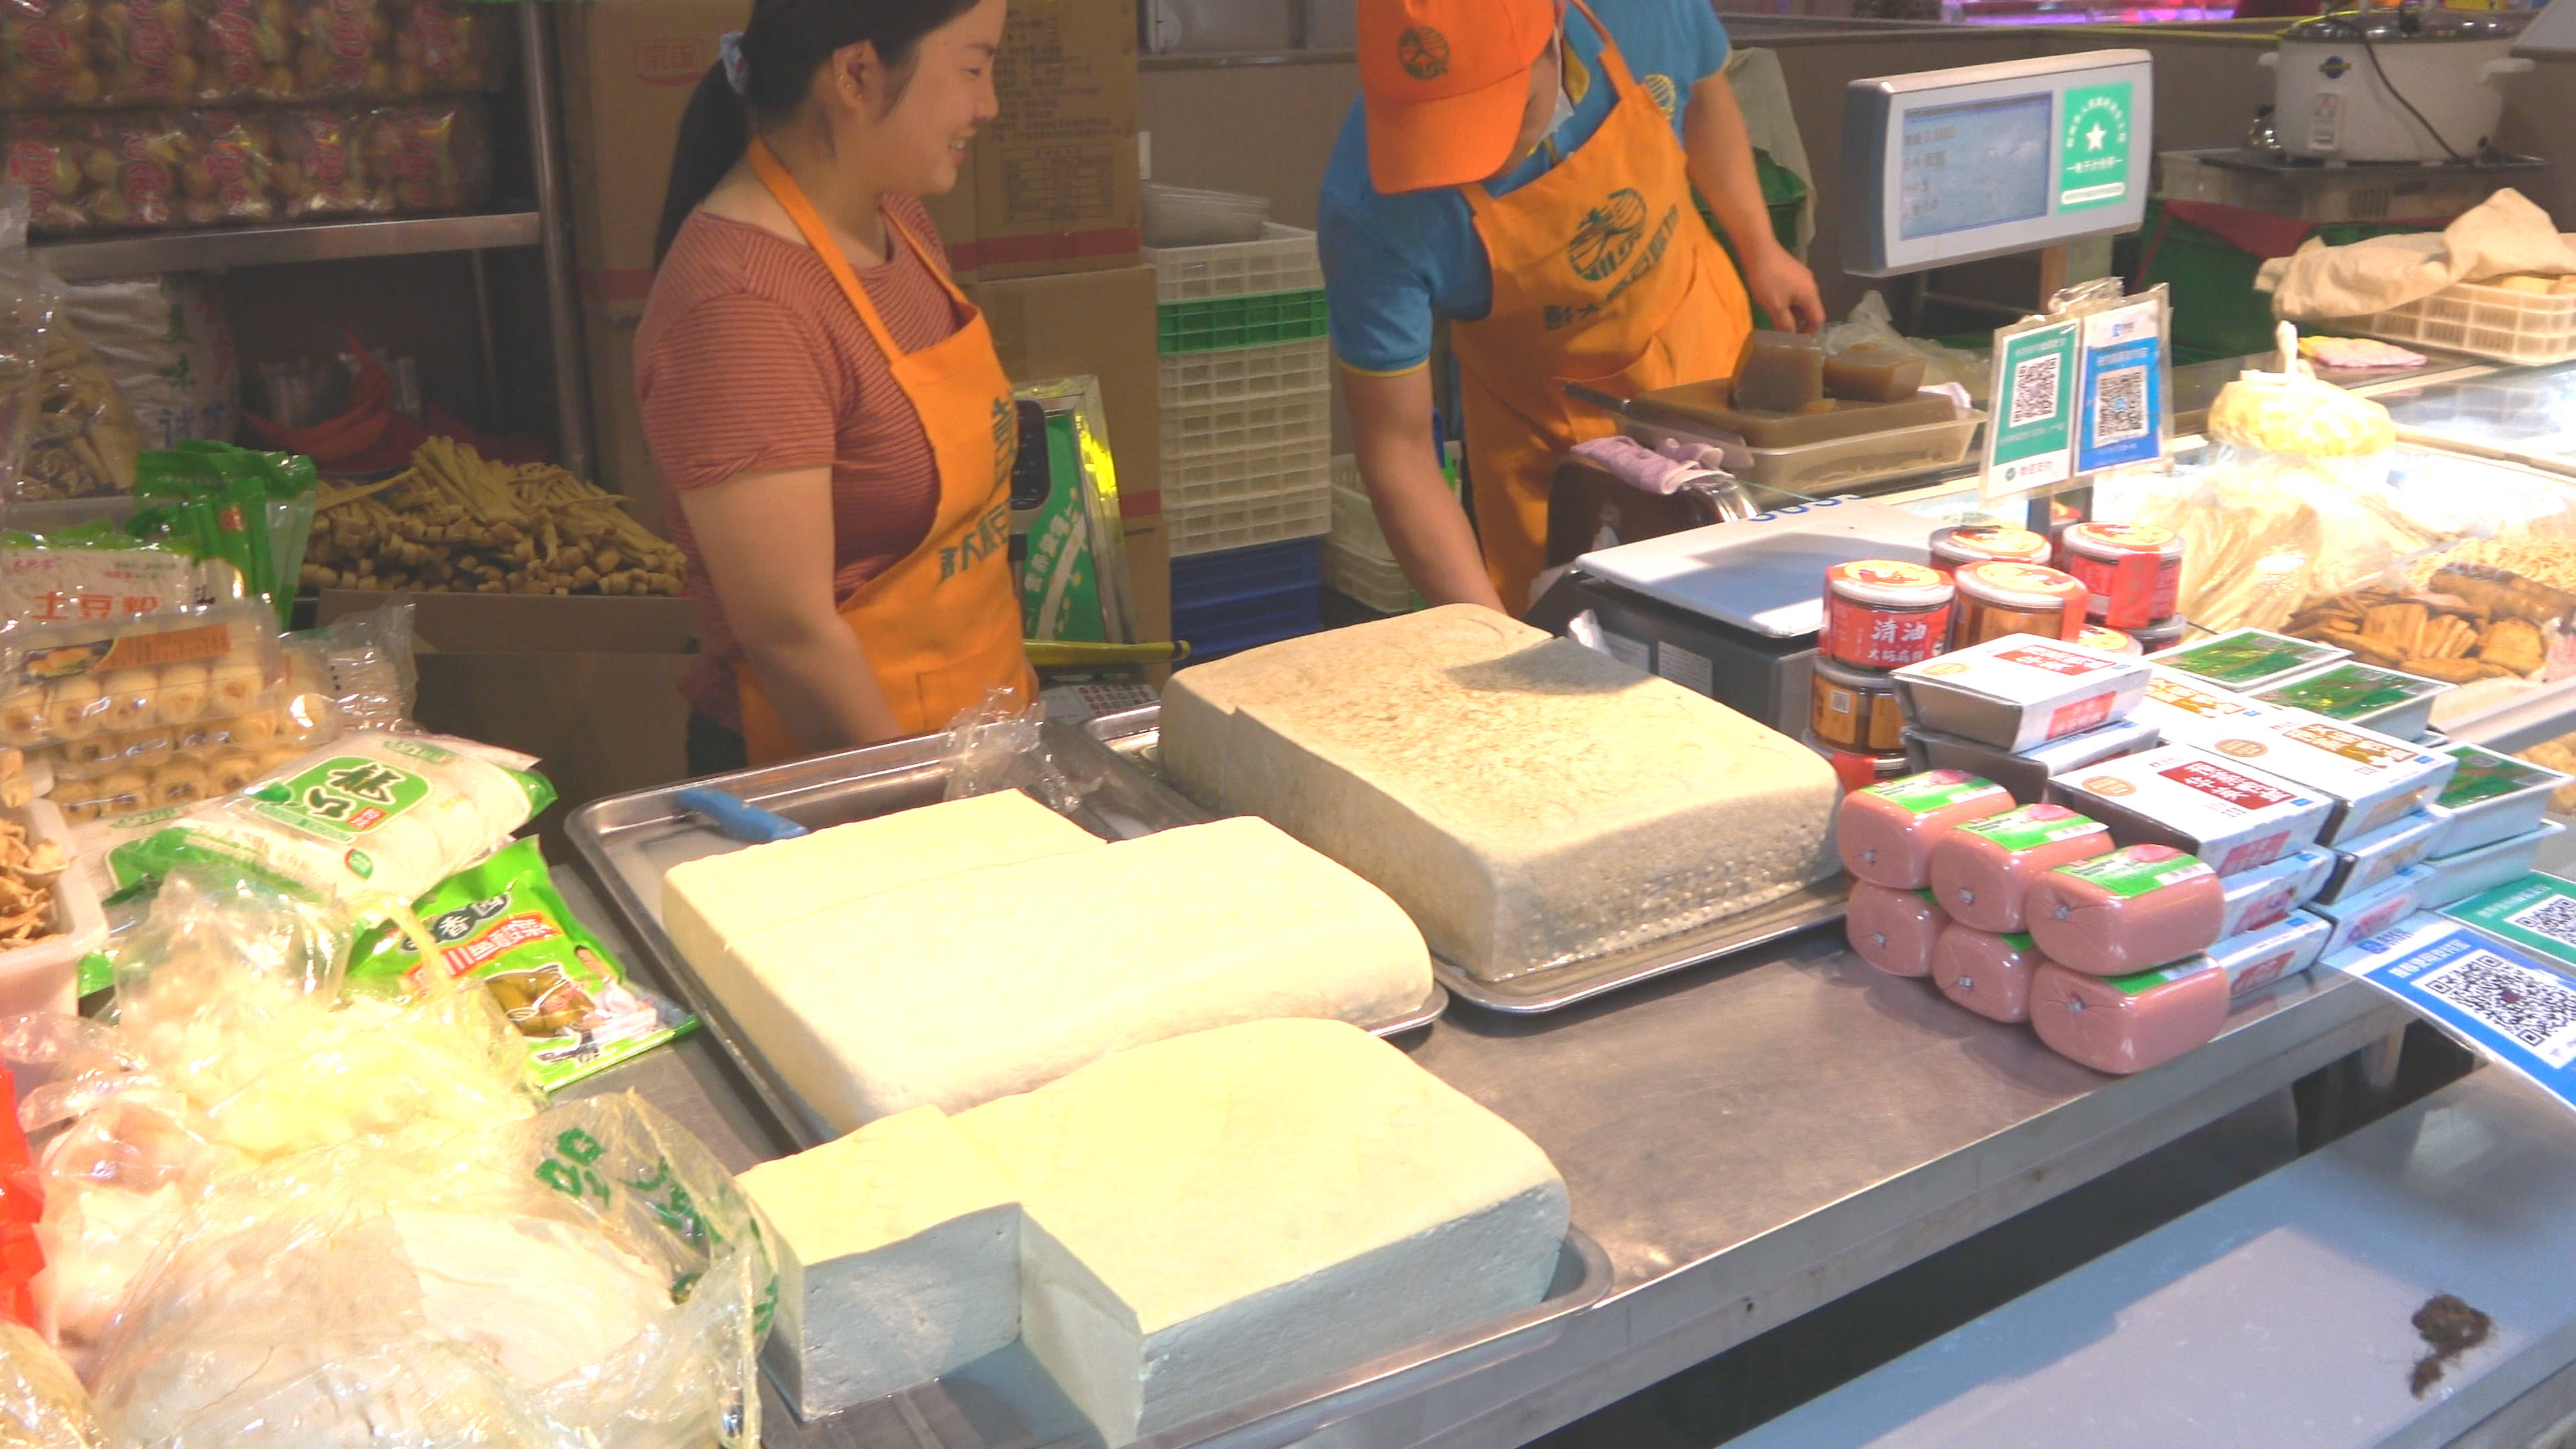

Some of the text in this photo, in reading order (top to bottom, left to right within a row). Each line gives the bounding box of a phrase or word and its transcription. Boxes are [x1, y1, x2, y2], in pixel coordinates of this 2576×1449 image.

[31, 590, 160, 621] 土豆粉
[1870, 618, 1928, 643] 清油
